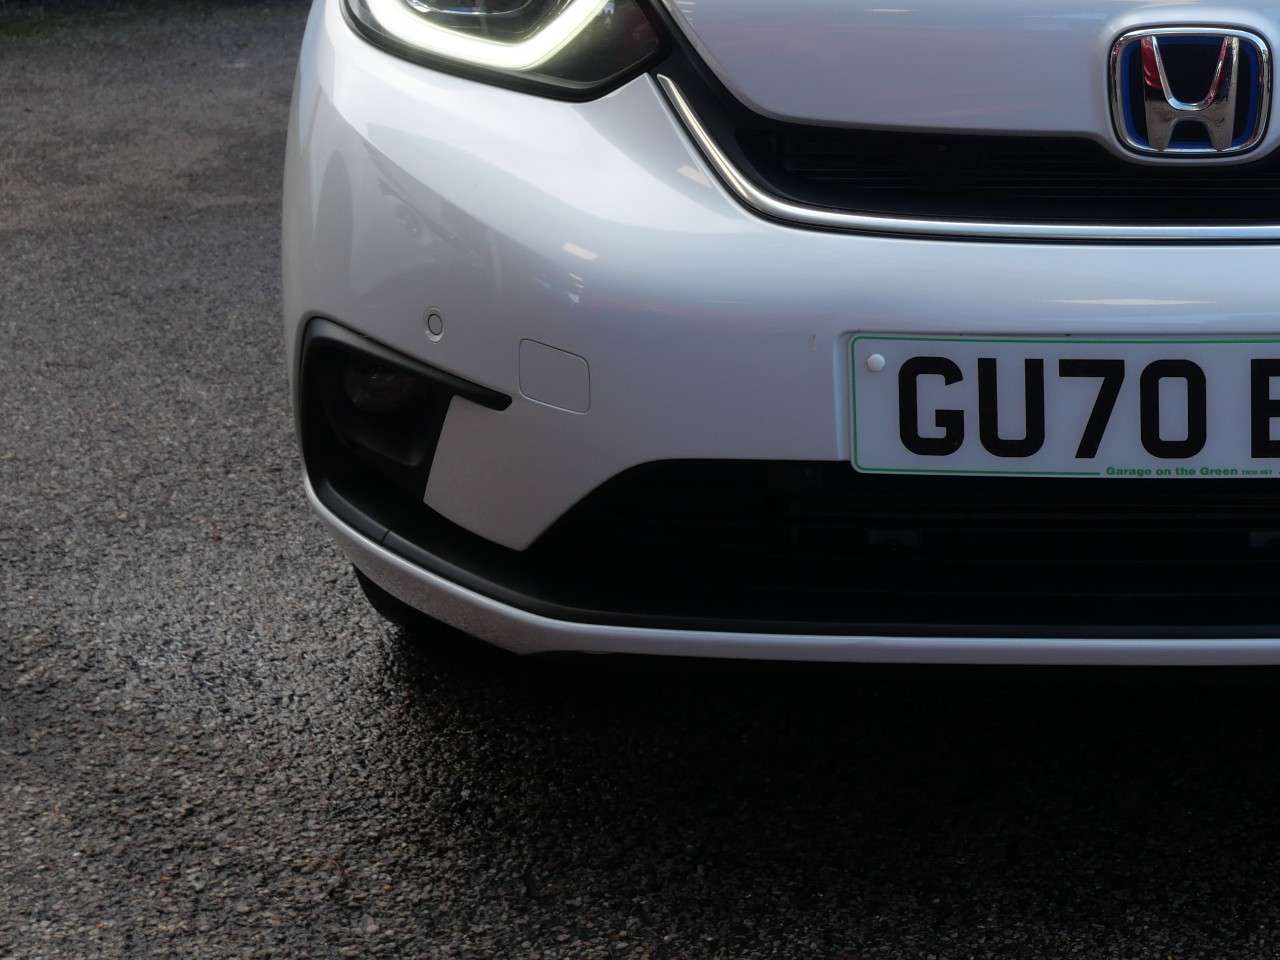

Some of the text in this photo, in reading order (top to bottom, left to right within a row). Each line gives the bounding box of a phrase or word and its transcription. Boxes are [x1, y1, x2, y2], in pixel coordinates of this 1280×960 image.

[898, 356, 1208, 459] GU70
[1105, 466, 1151, 477] Garage
[1155, 468, 1172, 476] on
[1175, 466, 1196, 476] the
[1200, 466, 1239, 476] Green
